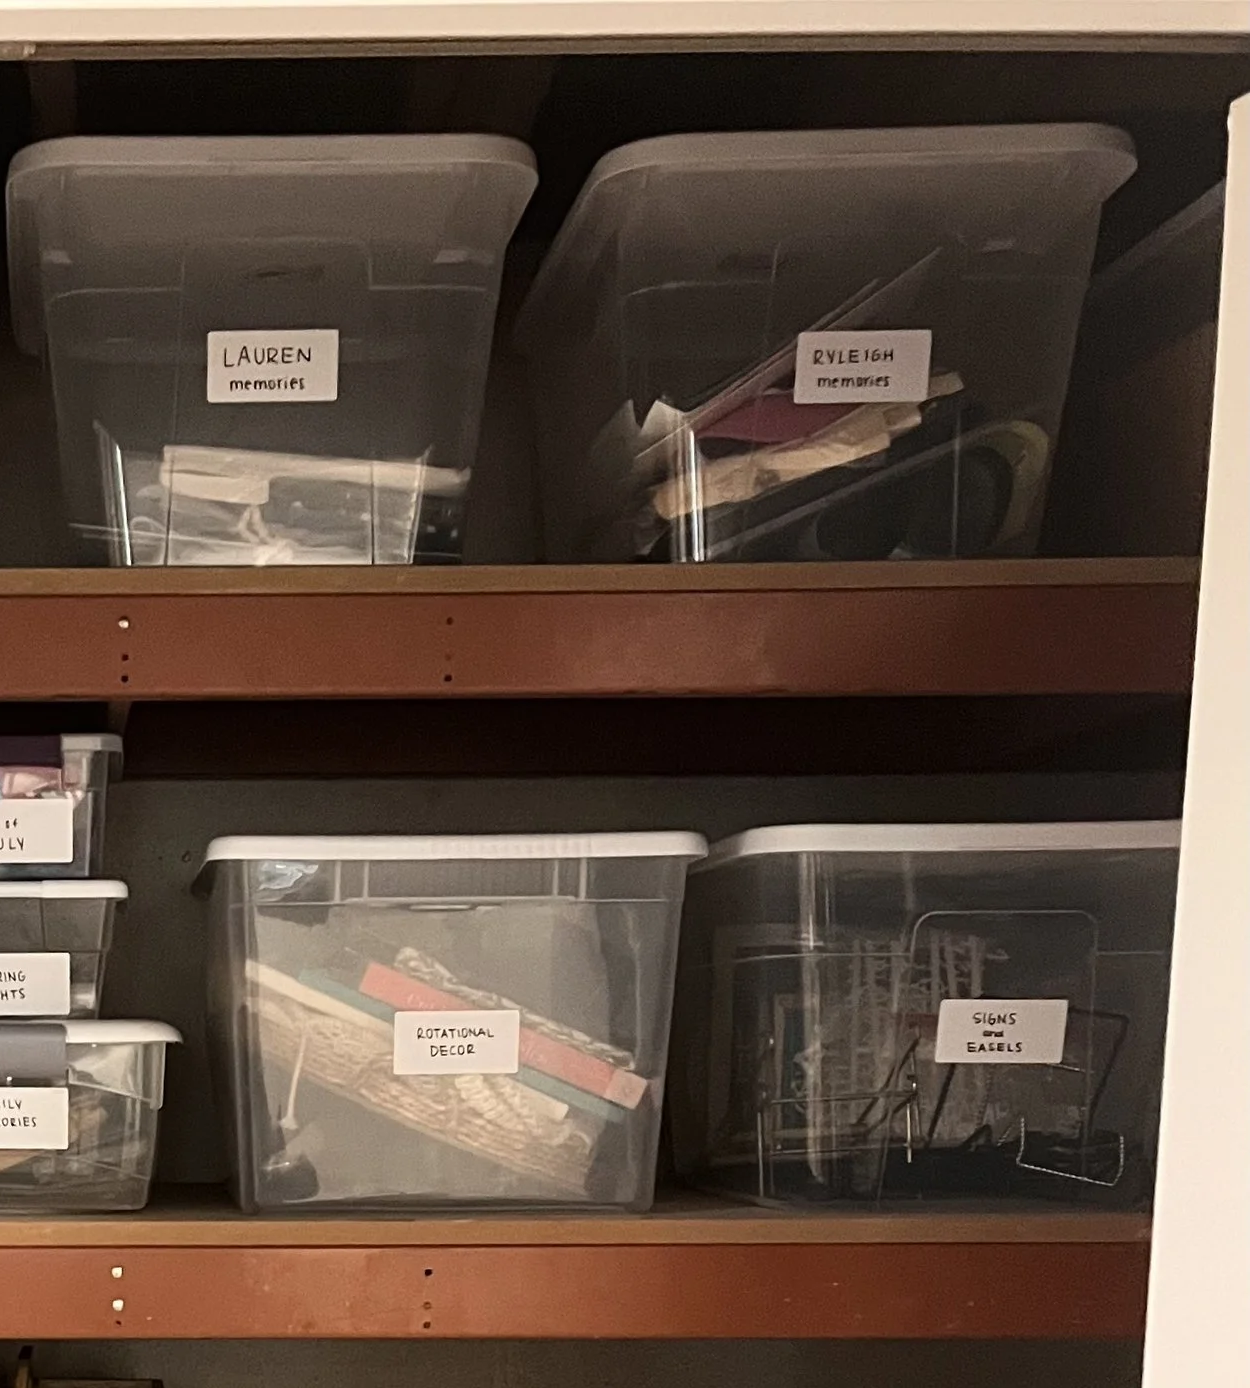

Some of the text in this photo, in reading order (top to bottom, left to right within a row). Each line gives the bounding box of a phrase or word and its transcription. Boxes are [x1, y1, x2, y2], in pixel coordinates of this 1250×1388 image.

[223, 347, 312, 367] LAUREN
[813, 349, 894, 365] RYLEIGH
[230, 377, 305, 390] memories
[817, 375, 890, 387] memories
[972, 1012, 1016, 1024] SIGNS
[417, 1028, 494, 1040] ROTATIONAL
[983, 1029, 1004, 1037] and
[430, 1044, 475, 1057] DECOR
[967, 1042, 1022, 1053] EASELS
